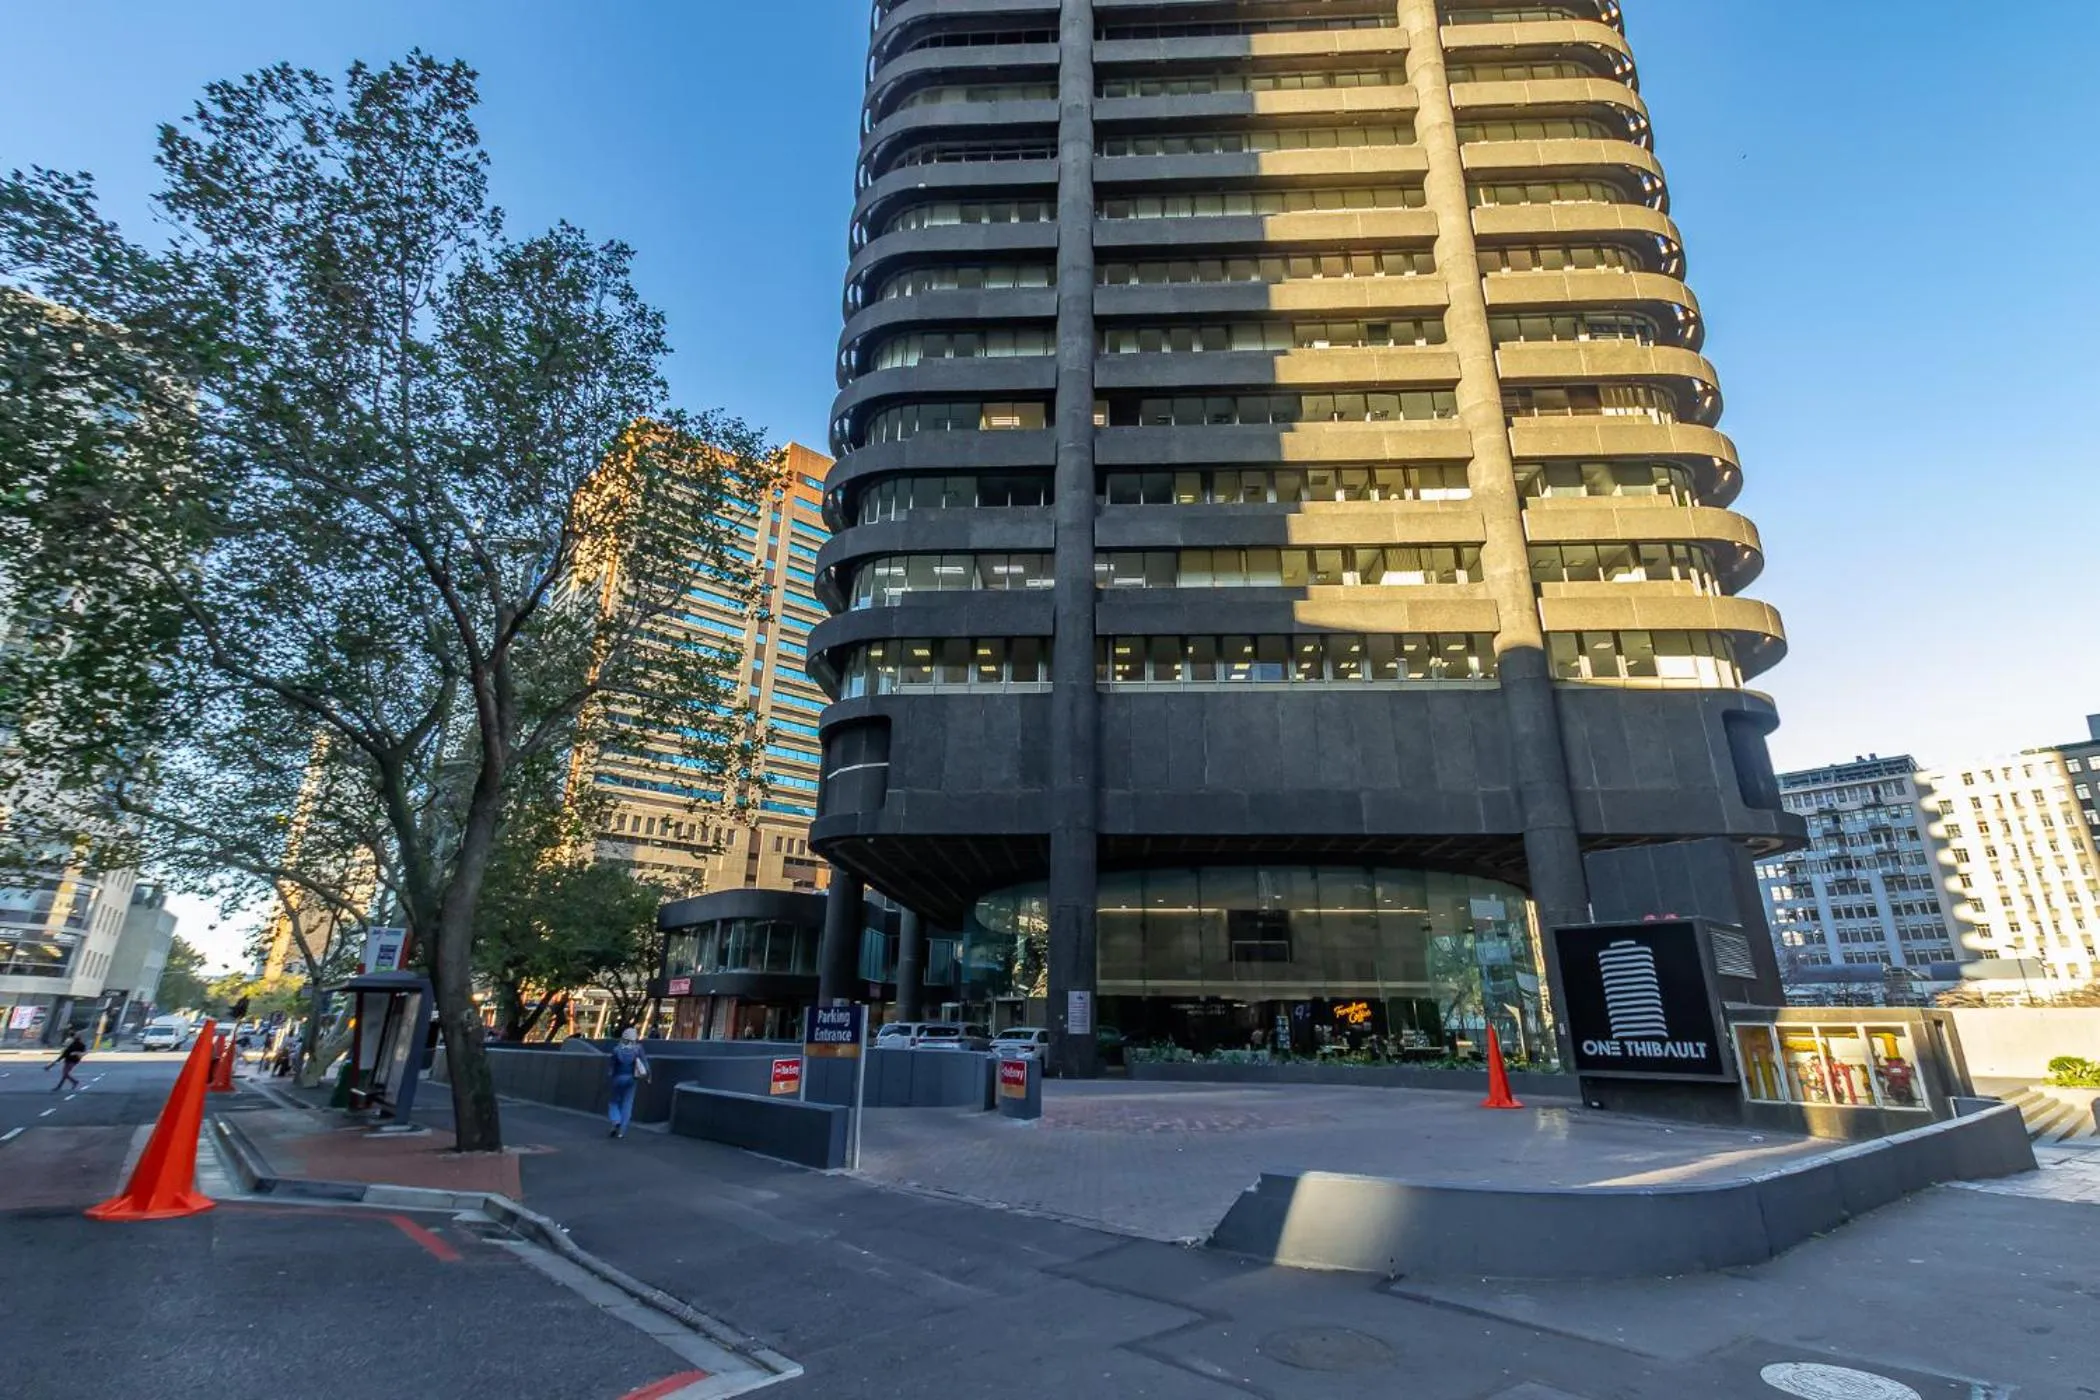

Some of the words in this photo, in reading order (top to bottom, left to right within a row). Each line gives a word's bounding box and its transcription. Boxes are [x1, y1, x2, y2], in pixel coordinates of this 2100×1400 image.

[817, 1008, 851, 1027] Parking
[814, 1027, 852, 1041] Entrance
[1582, 1040, 1622, 1056] ONE
[1623, 1041, 1707, 1059] THIBAULT
